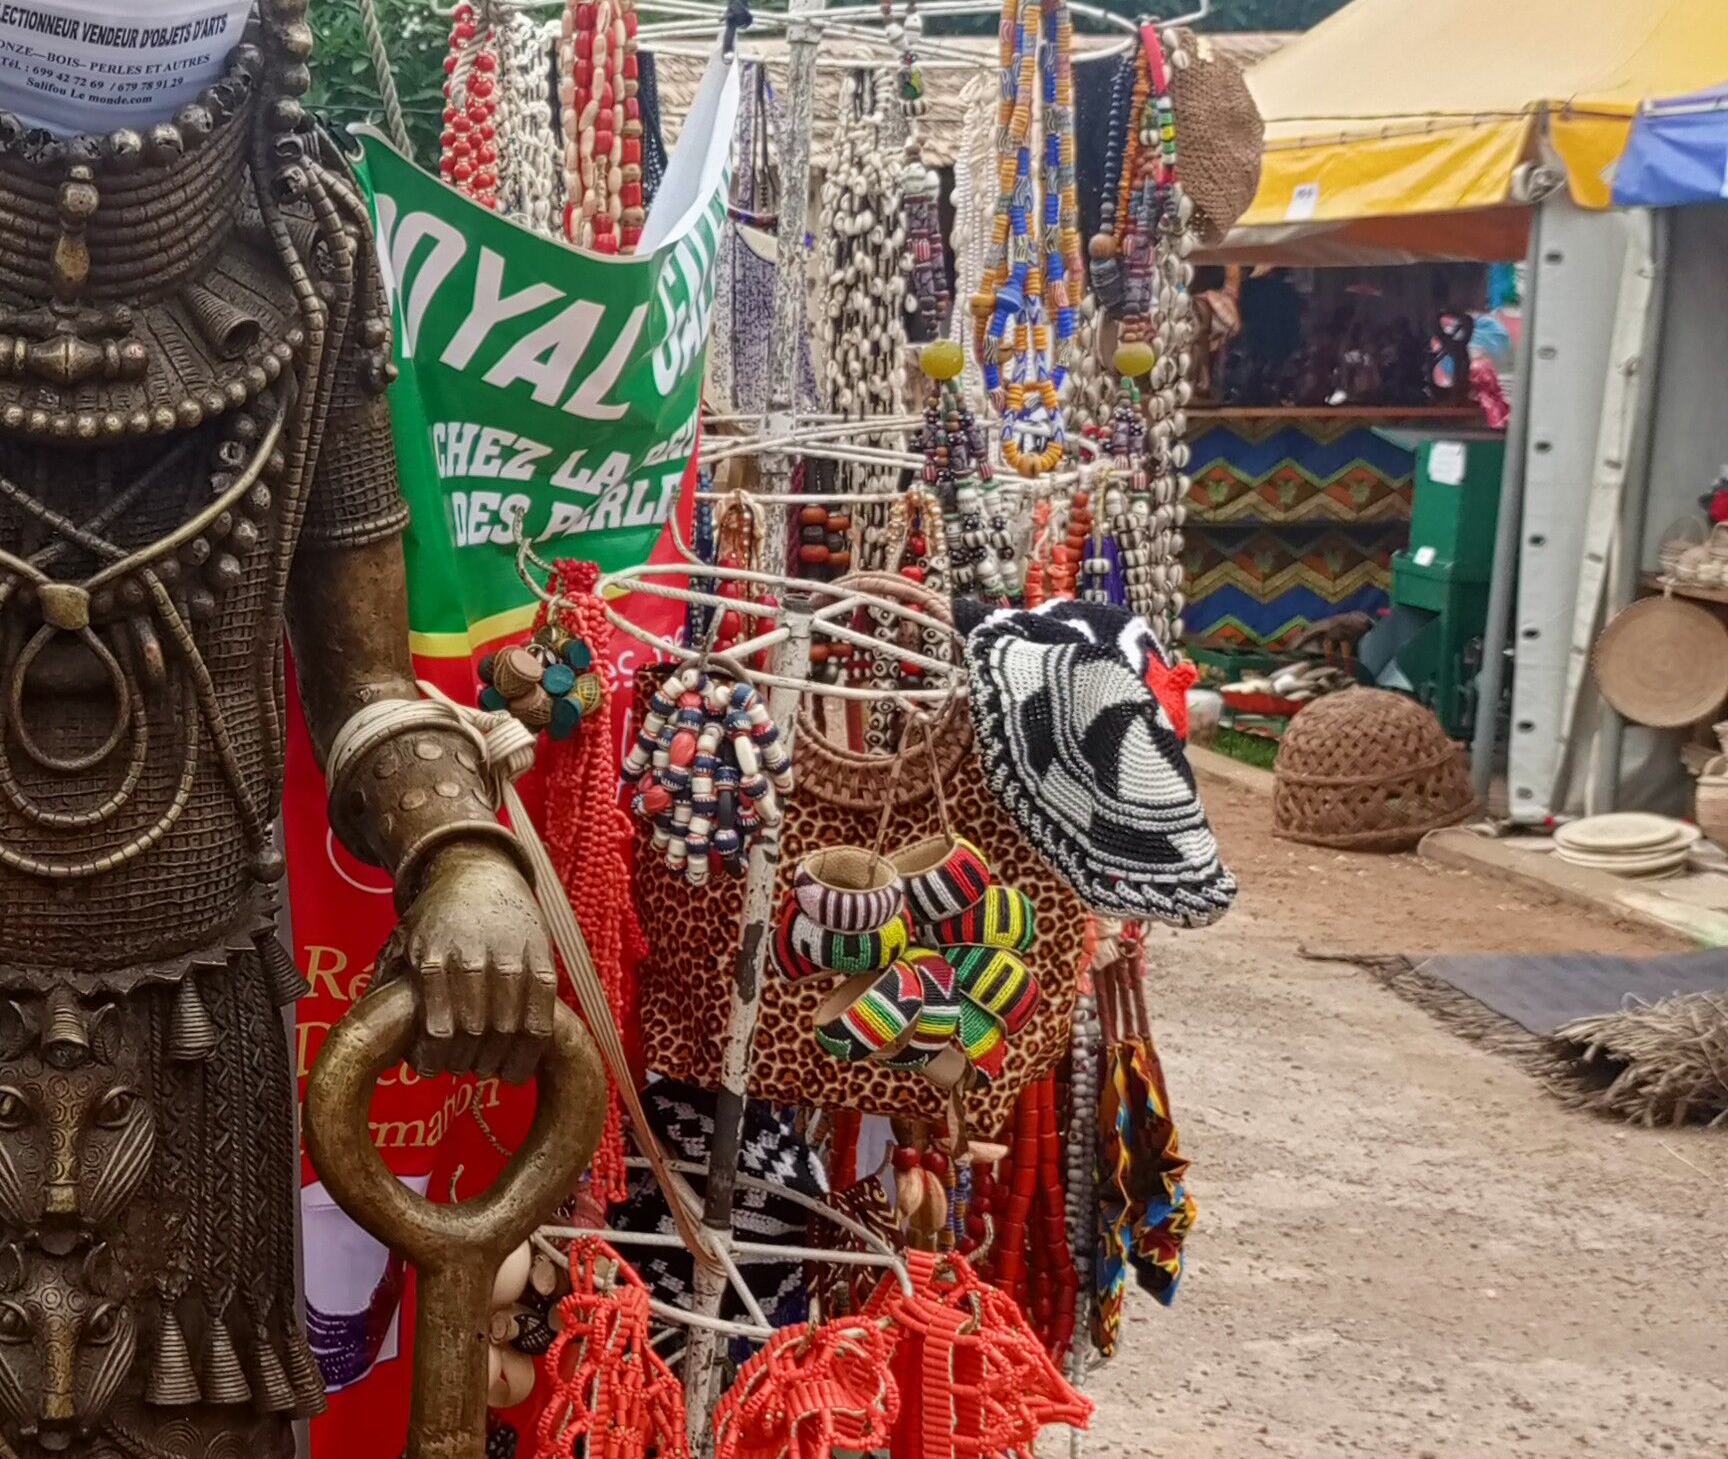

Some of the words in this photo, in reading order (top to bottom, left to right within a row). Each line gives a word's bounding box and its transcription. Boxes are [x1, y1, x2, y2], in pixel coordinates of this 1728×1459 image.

[81, 22, 139, 48] VENDEUR
[139, 23, 193, 49] D'OBJETS
[192, 12, 229, 41] D'ARTS
[32, 66, 54, 78] 699
[56, 73, 70, 83] 42
[73, 76, 87, 87] 72
[89, 62, 142, 75] PERLES
[26, 76, 67, 96] Salifou
[70, 88, 86, 100] Le
[432, 420, 554, 482] CHEZ
[549, 449, 632, 496] LA
[450, 490, 533, 548] DES
